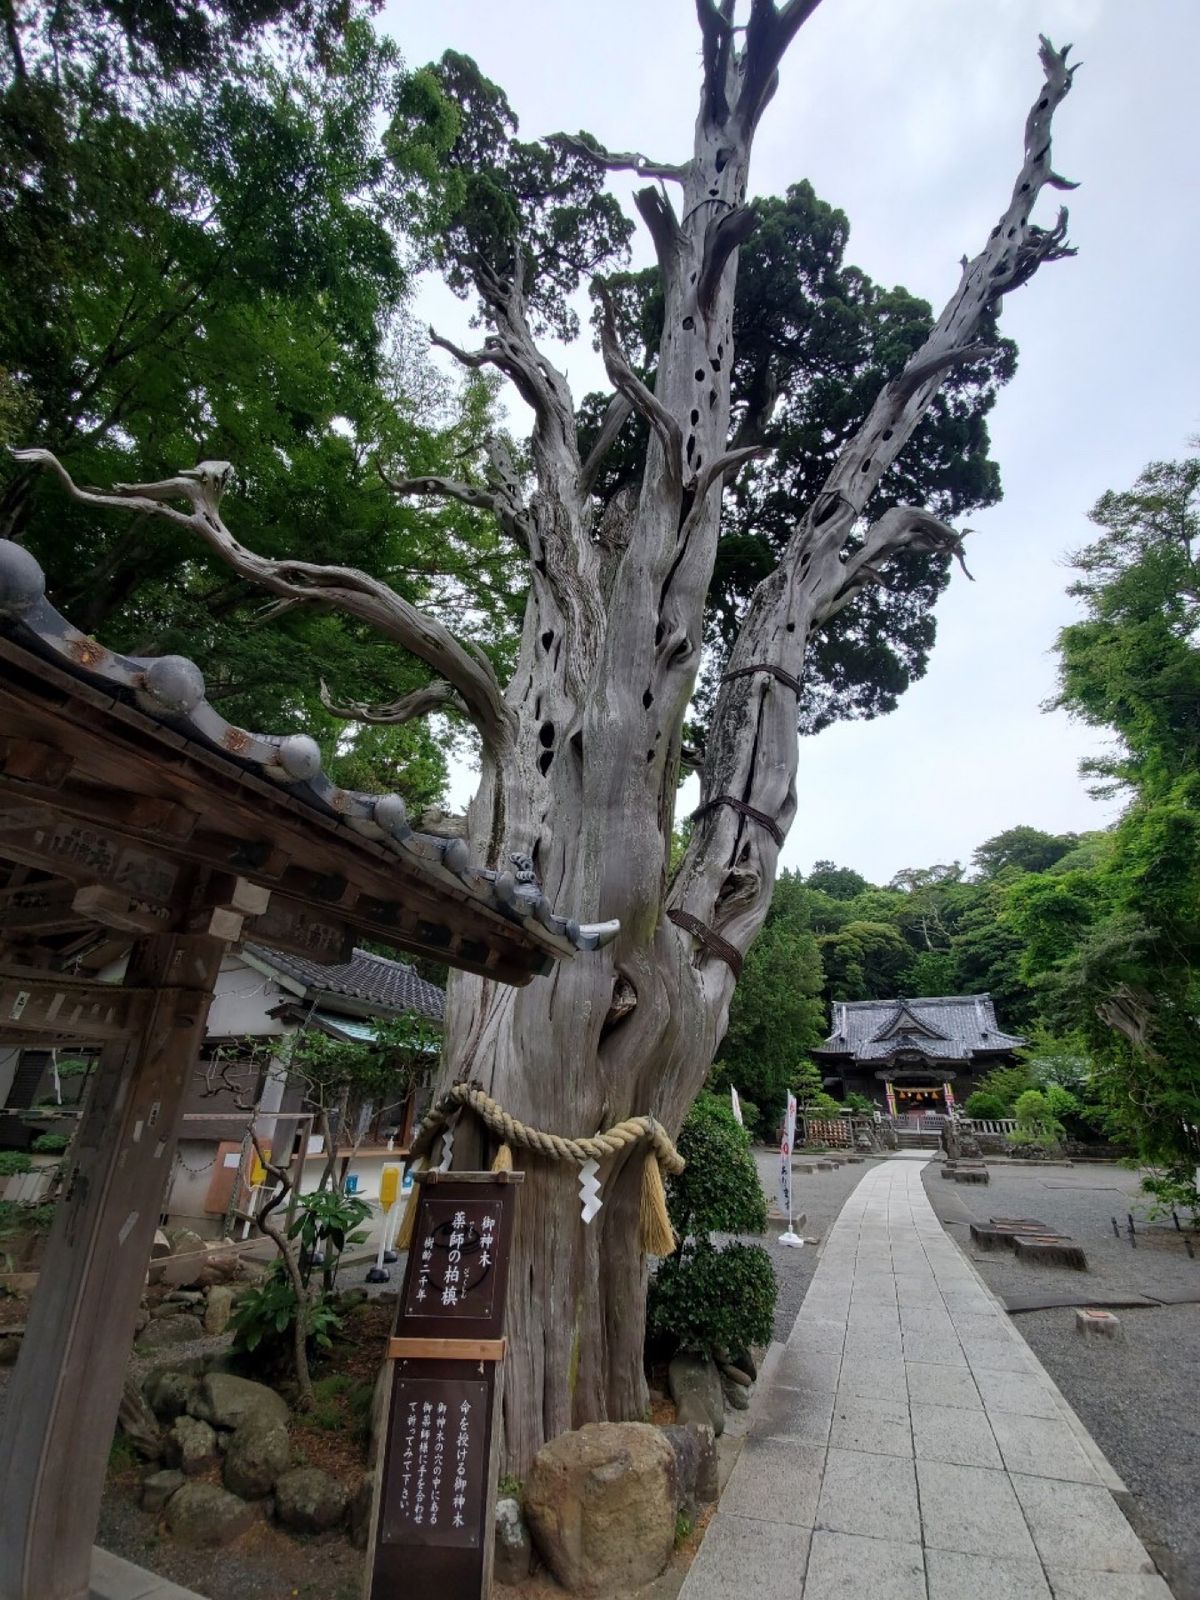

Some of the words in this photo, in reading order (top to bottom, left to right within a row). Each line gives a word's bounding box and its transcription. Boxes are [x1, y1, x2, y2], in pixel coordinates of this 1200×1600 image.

[415, 1236, 435, 1302] 樹齢二千年
[479, 1215, 496, 1268] 御神木
[429, 1401, 448, 1525] 御神木の穴の中にある
[451, 1399, 472, 1527] 命を授ける御神木
